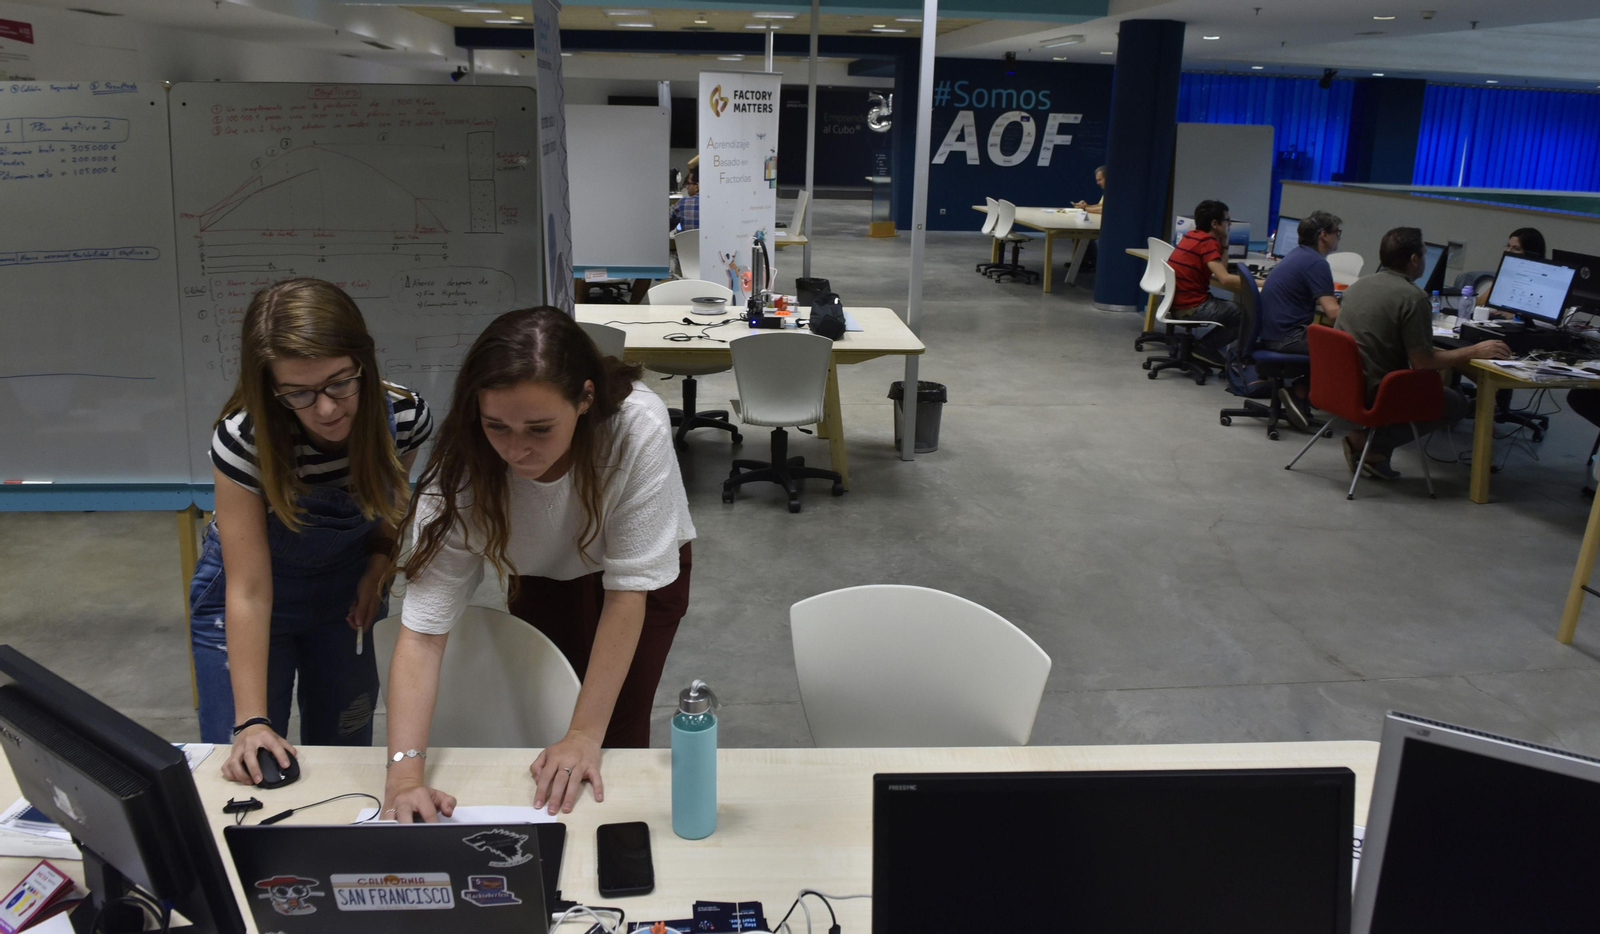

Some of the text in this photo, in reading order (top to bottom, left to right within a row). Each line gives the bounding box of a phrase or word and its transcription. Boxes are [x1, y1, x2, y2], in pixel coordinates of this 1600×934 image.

[733, 90, 773, 101] FACTORY
[934, 81, 1051, 110] #Somos
[733, 103, 773, 114] MATTERS
[102, 120, 110, 131] 2
[823, 125, 855, 134] al Cubo
[706, 137, 750, 150] Aprendizaje
[931, 110, 1083, 168] AOF
[713, 155, 741, 168] Basado
[412, 278, 435, 288] Ahorro
[478, 276, 489, 286] de
[357, 877, 425, 886] CALIFORNIA
[338, 887, 451, 905] SAN FRANCISCO
